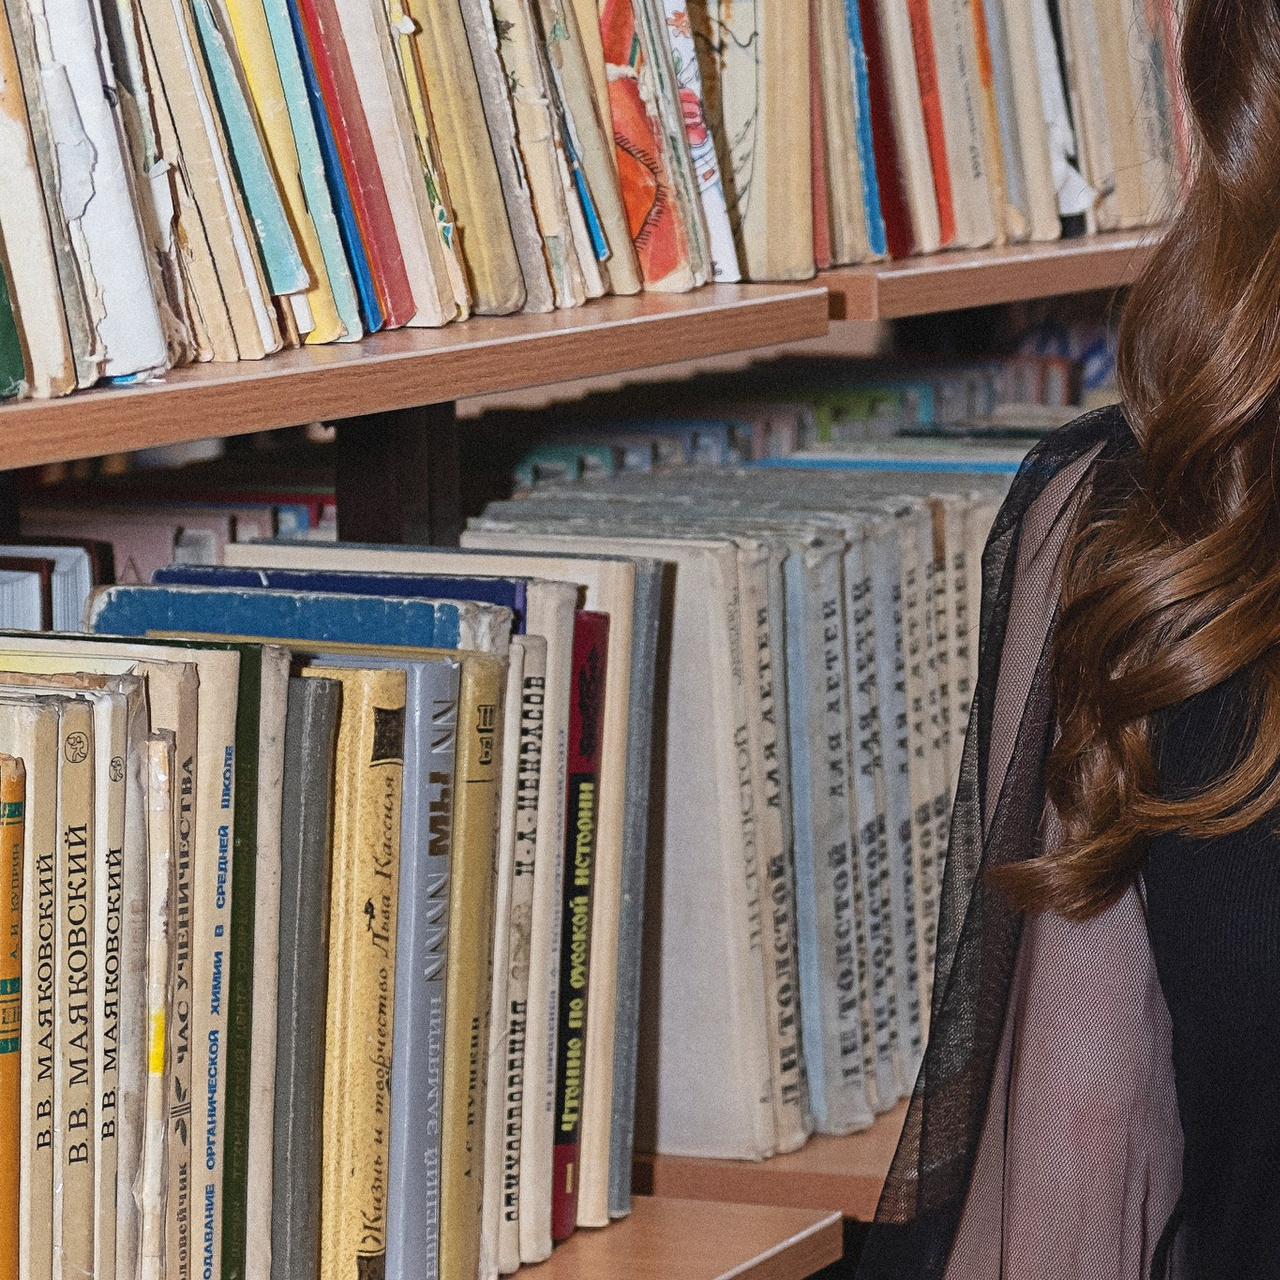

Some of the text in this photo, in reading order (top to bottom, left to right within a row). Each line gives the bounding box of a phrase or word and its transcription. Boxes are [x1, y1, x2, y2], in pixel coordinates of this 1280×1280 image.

[215, 825, 230, 910] СРЕДНЕЙ
[220, 745, 234, 811] ШКОЛЕ
[10, 841, 21, 911] КУПРИН
[64, 823, 89, 1087] МАЯКОВСКИЙ
[103, 847, 122, 1073] МАЯКОВСКИЙ
[176, 754, 193, 990] УЧЕНИЧЕСТВА
[214, 924, 224, 938] В
[766, 852, 796, 1036] ТОЛСТОЙ
[827, 840, 857, 1021] ТОЛСТОЙ
[36, 852, 55, 1082] МАЯКОВСКИЙ
[176, 1000, 189, 1065] ЧАС
[210, 950, 224, 1016] ХИМИИ
[359, 774, 396, 1246] Жизнь и творчество Льва Кассиля
[423, 771, 451, 1280] ЕВГЕНИЙ ЗАМЯТИН МЫ
[205, 1029, 221, 1172] ОРГАНИЧЕСКОЙ
